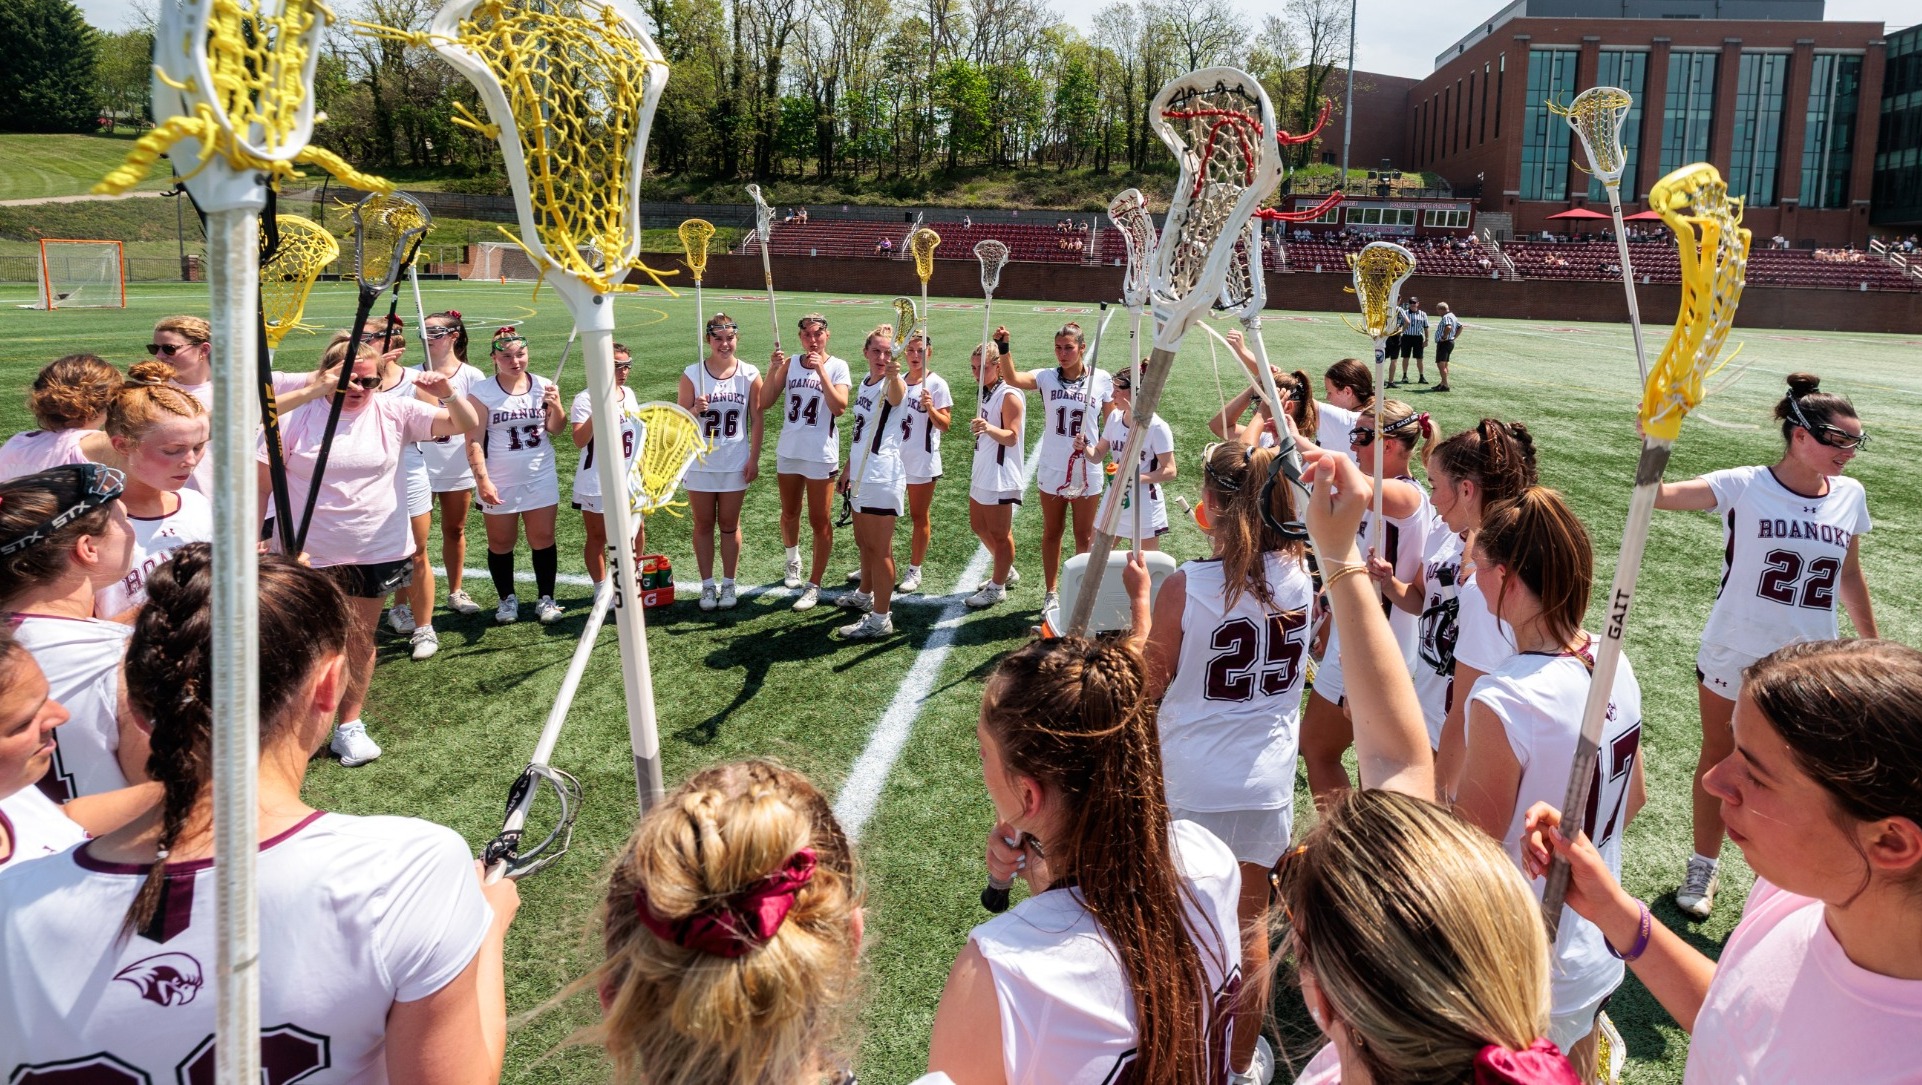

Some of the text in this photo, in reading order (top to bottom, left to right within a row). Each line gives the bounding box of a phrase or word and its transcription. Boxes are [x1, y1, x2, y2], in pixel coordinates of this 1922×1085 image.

[706, 392, 745, 405] OANOKE
[787, 393, 821, 427] 34
[1050, 389, 1097, 409] ROANOE
[506, 423, 542, 452] 13
[702, 408, 741, 439] 26
[1055, 405, 1088, 439] 12
[620, 428, 634, 460] 6
[50, 500, 92, 530] STX
[1, 530, 44, 556] STX
[1757, 518, 1852, 550] ROANOKE
[643, 578, 651, 587] G
[1756, 548, 1842, 612] 22
[644, 592, 657, 607] G
[1607, 588, 1631, 641] GAIT
[1203, 603, 1309, 703] 25
